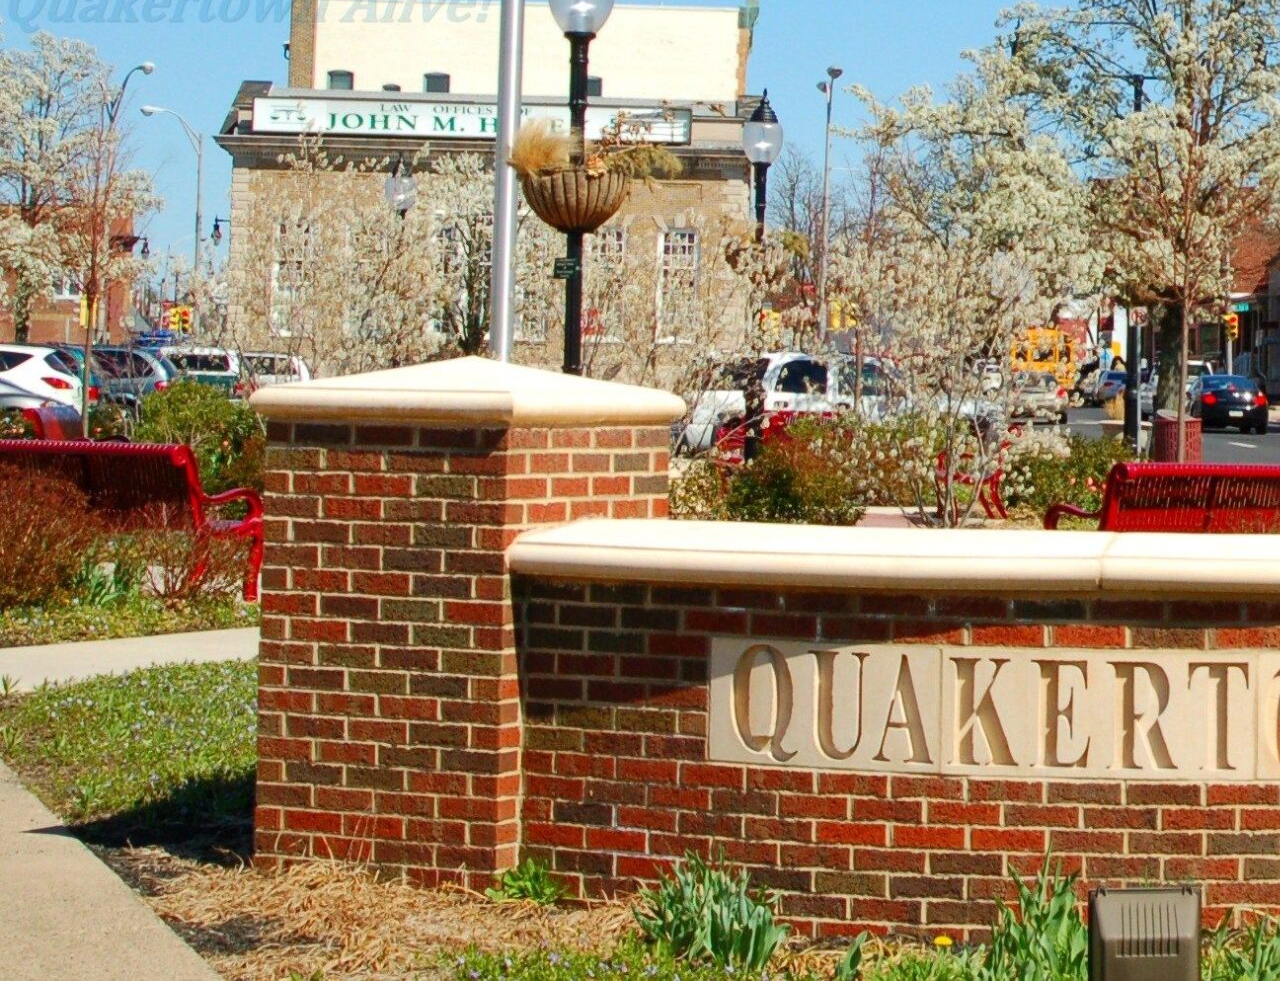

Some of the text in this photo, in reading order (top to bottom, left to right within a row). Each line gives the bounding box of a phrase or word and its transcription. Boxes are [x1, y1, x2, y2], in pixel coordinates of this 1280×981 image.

[381, 103, 412, 113] LAW
[432, 105, 494, 116] OFFICES
[326, 112, 418, 131] JOHN
[432, 116, 465, 132] M.
